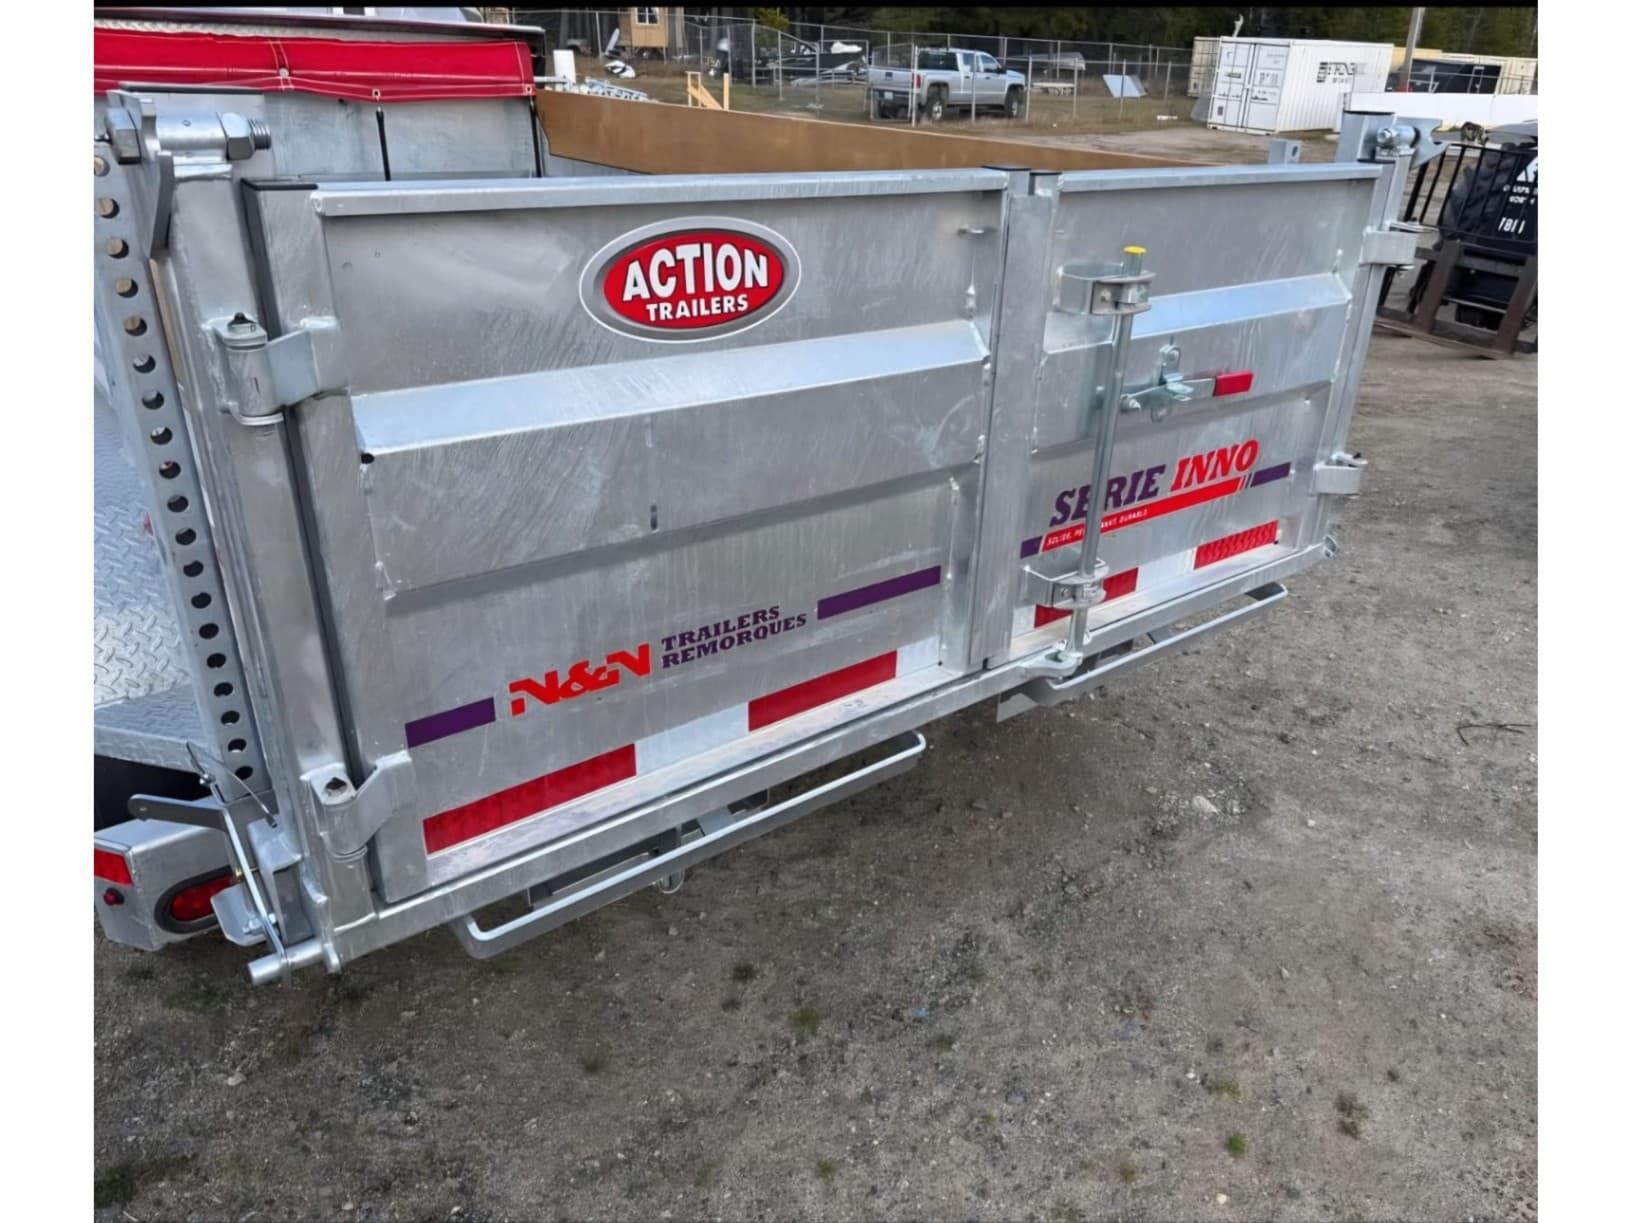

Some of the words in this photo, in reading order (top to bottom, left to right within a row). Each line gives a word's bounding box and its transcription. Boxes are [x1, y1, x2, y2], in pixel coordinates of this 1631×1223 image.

[622, 243, 769, 301] ACTION
[646, 294, 749, 322] TRAILERS
[1049, 464, 1167, 527] SERIE
[1170, 439, 1259, 492] INNO
[661, 605, 780, 651] TRAILERS
[662, 613, 807, 669] REMORQUES
[508, 642, 651, 716] N&N
